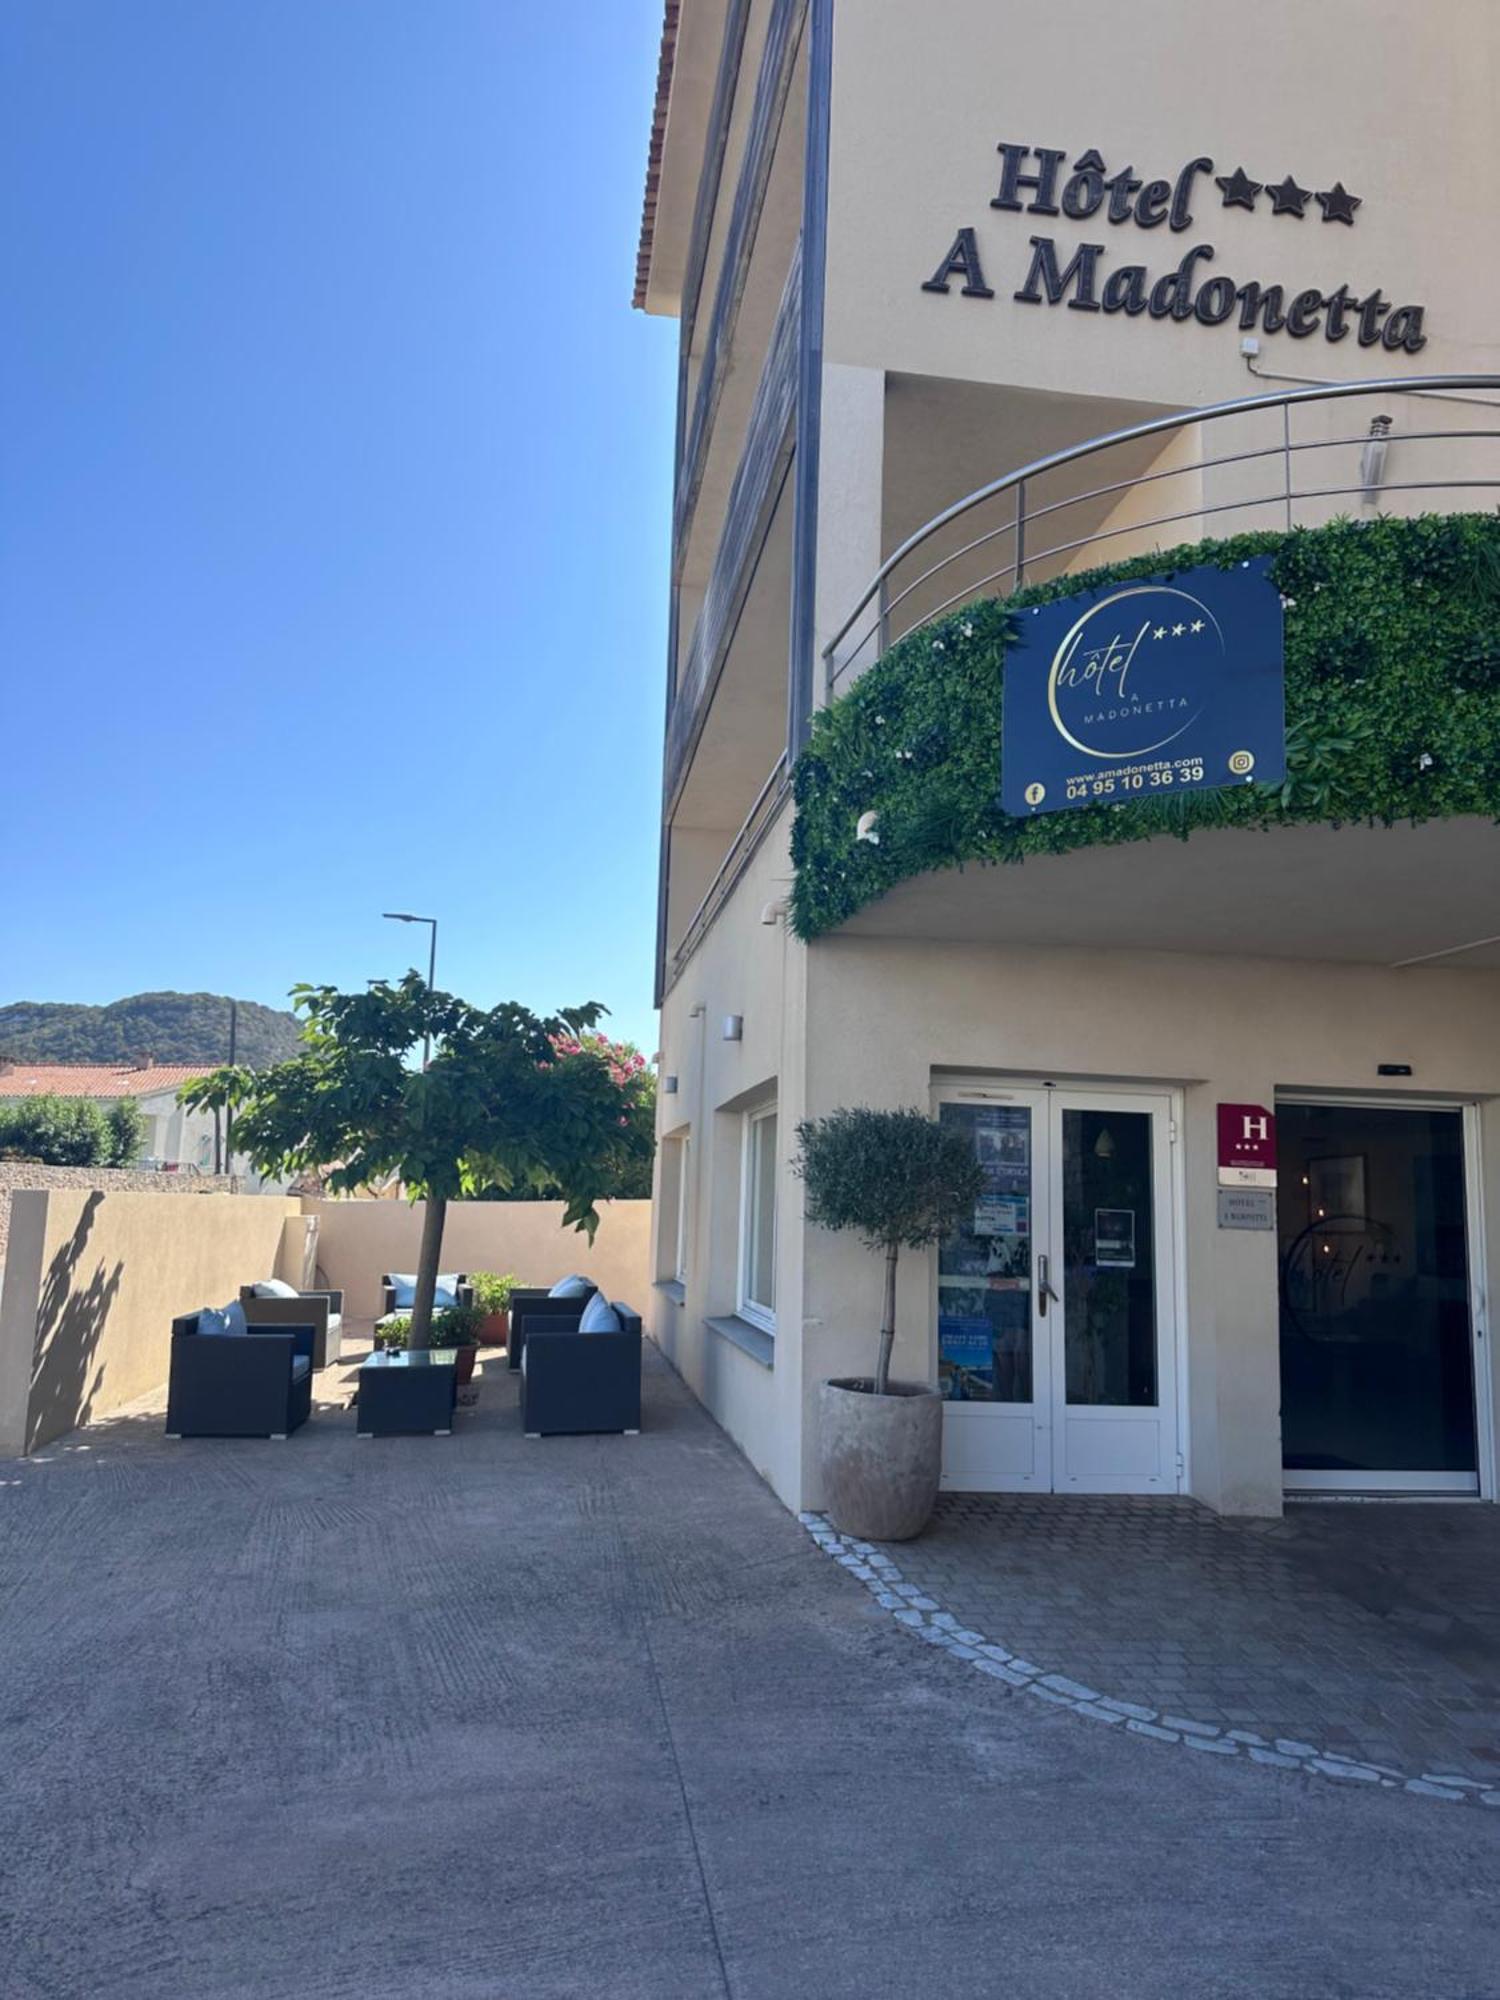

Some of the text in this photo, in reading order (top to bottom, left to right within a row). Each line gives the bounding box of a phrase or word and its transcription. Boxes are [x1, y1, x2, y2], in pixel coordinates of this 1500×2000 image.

[990, 142, 1214, 232] Hôtel
[921, 227, 1427, 354] A Madonetta
[1084, 698, 1188, 724] MADONETTA
[1131, 693, 1139, 701] A
[1066, 757, 1203, 785] www.amadonetta.com
[1066, 766, 1204, 799] 04 95 10 36 39
[1242, 1116, 1268, 1140] H
